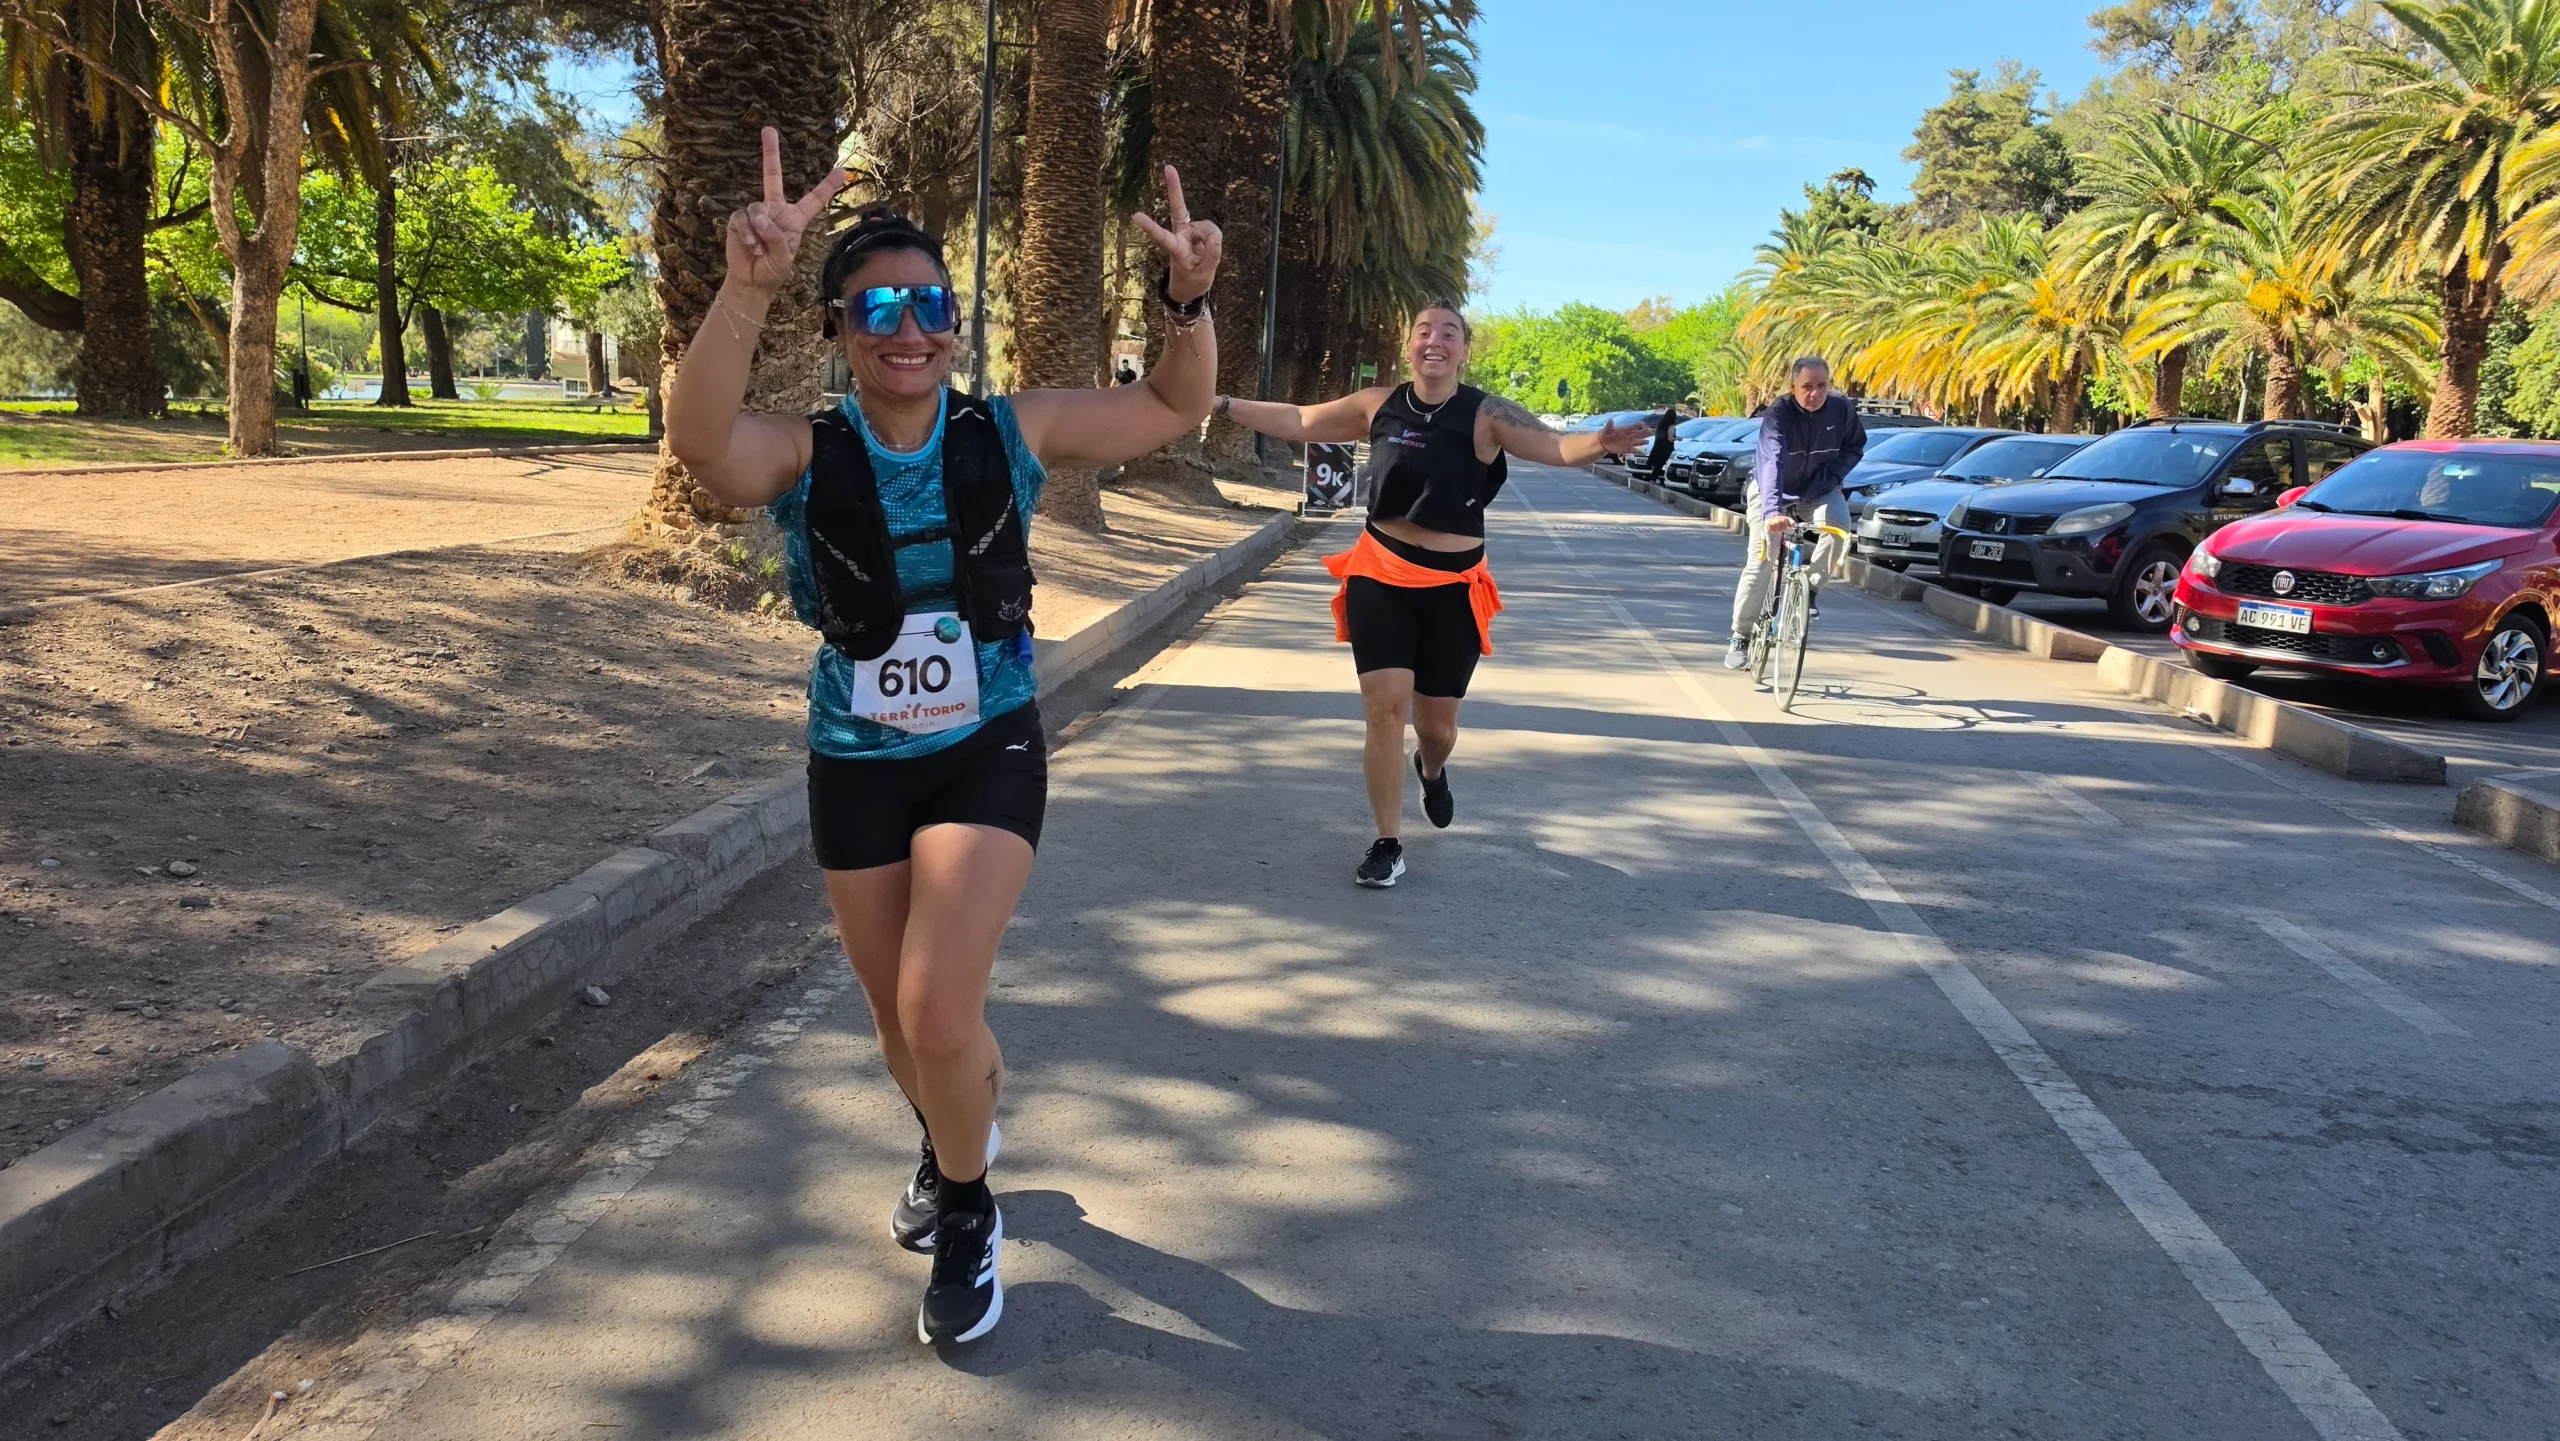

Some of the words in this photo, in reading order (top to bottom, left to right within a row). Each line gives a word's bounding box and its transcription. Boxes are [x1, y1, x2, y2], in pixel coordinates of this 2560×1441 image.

[1316, 463, 1344, 487] 9K
[2276, 577, 2291, 589] FIAT
[2240, 609, 2257, 623] AC
[2261, 612, 2285, 628] 991
[2291, 616, 2307, 630] VF
[878, 654, 951, 698] 610
[870, 702, 966, 721] TERRITORIO
